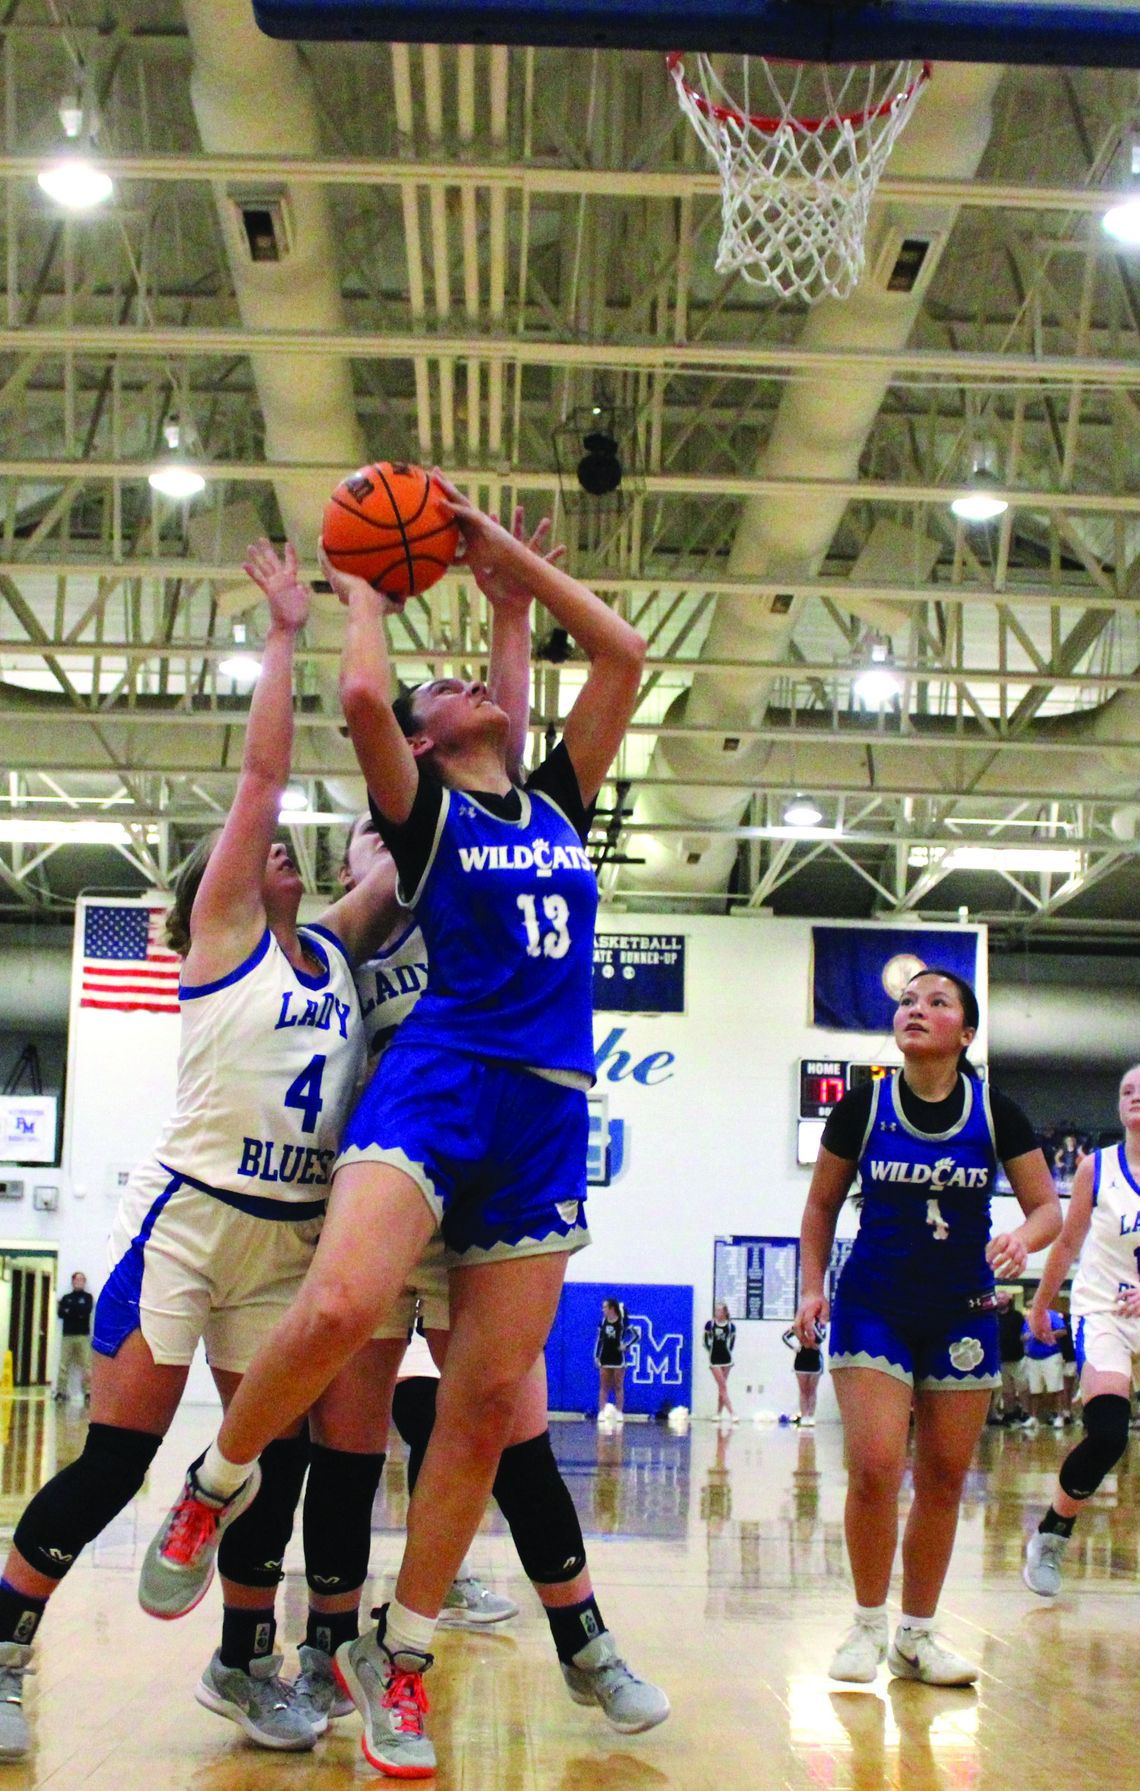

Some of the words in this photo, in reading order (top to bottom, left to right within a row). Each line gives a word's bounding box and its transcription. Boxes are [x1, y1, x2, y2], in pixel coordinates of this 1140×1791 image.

[458, 838, 592, 877] WILDCATS
[517, 894, 571, 959] 13
[594, 935, 682, 950] SKETBALL
[593, 949, 613, 963] ATE
[620, 950, 677, 965] RUNNER-UP
[357, 963, 428, 1021] LAD
[275, 991, 350, 1040] LADY
[594, 1027, 676, 1086] he
[807, 1063, 840, 1075] HOME
[284, 1054, 327, 1134] 4
[820, 1079, 844, 1104] 17
[237, 1137, 335, 1185] BLUES
[870, 1157, 989, 1190] WILDCATS
[1119, 1210, 1140, 1236] LA
